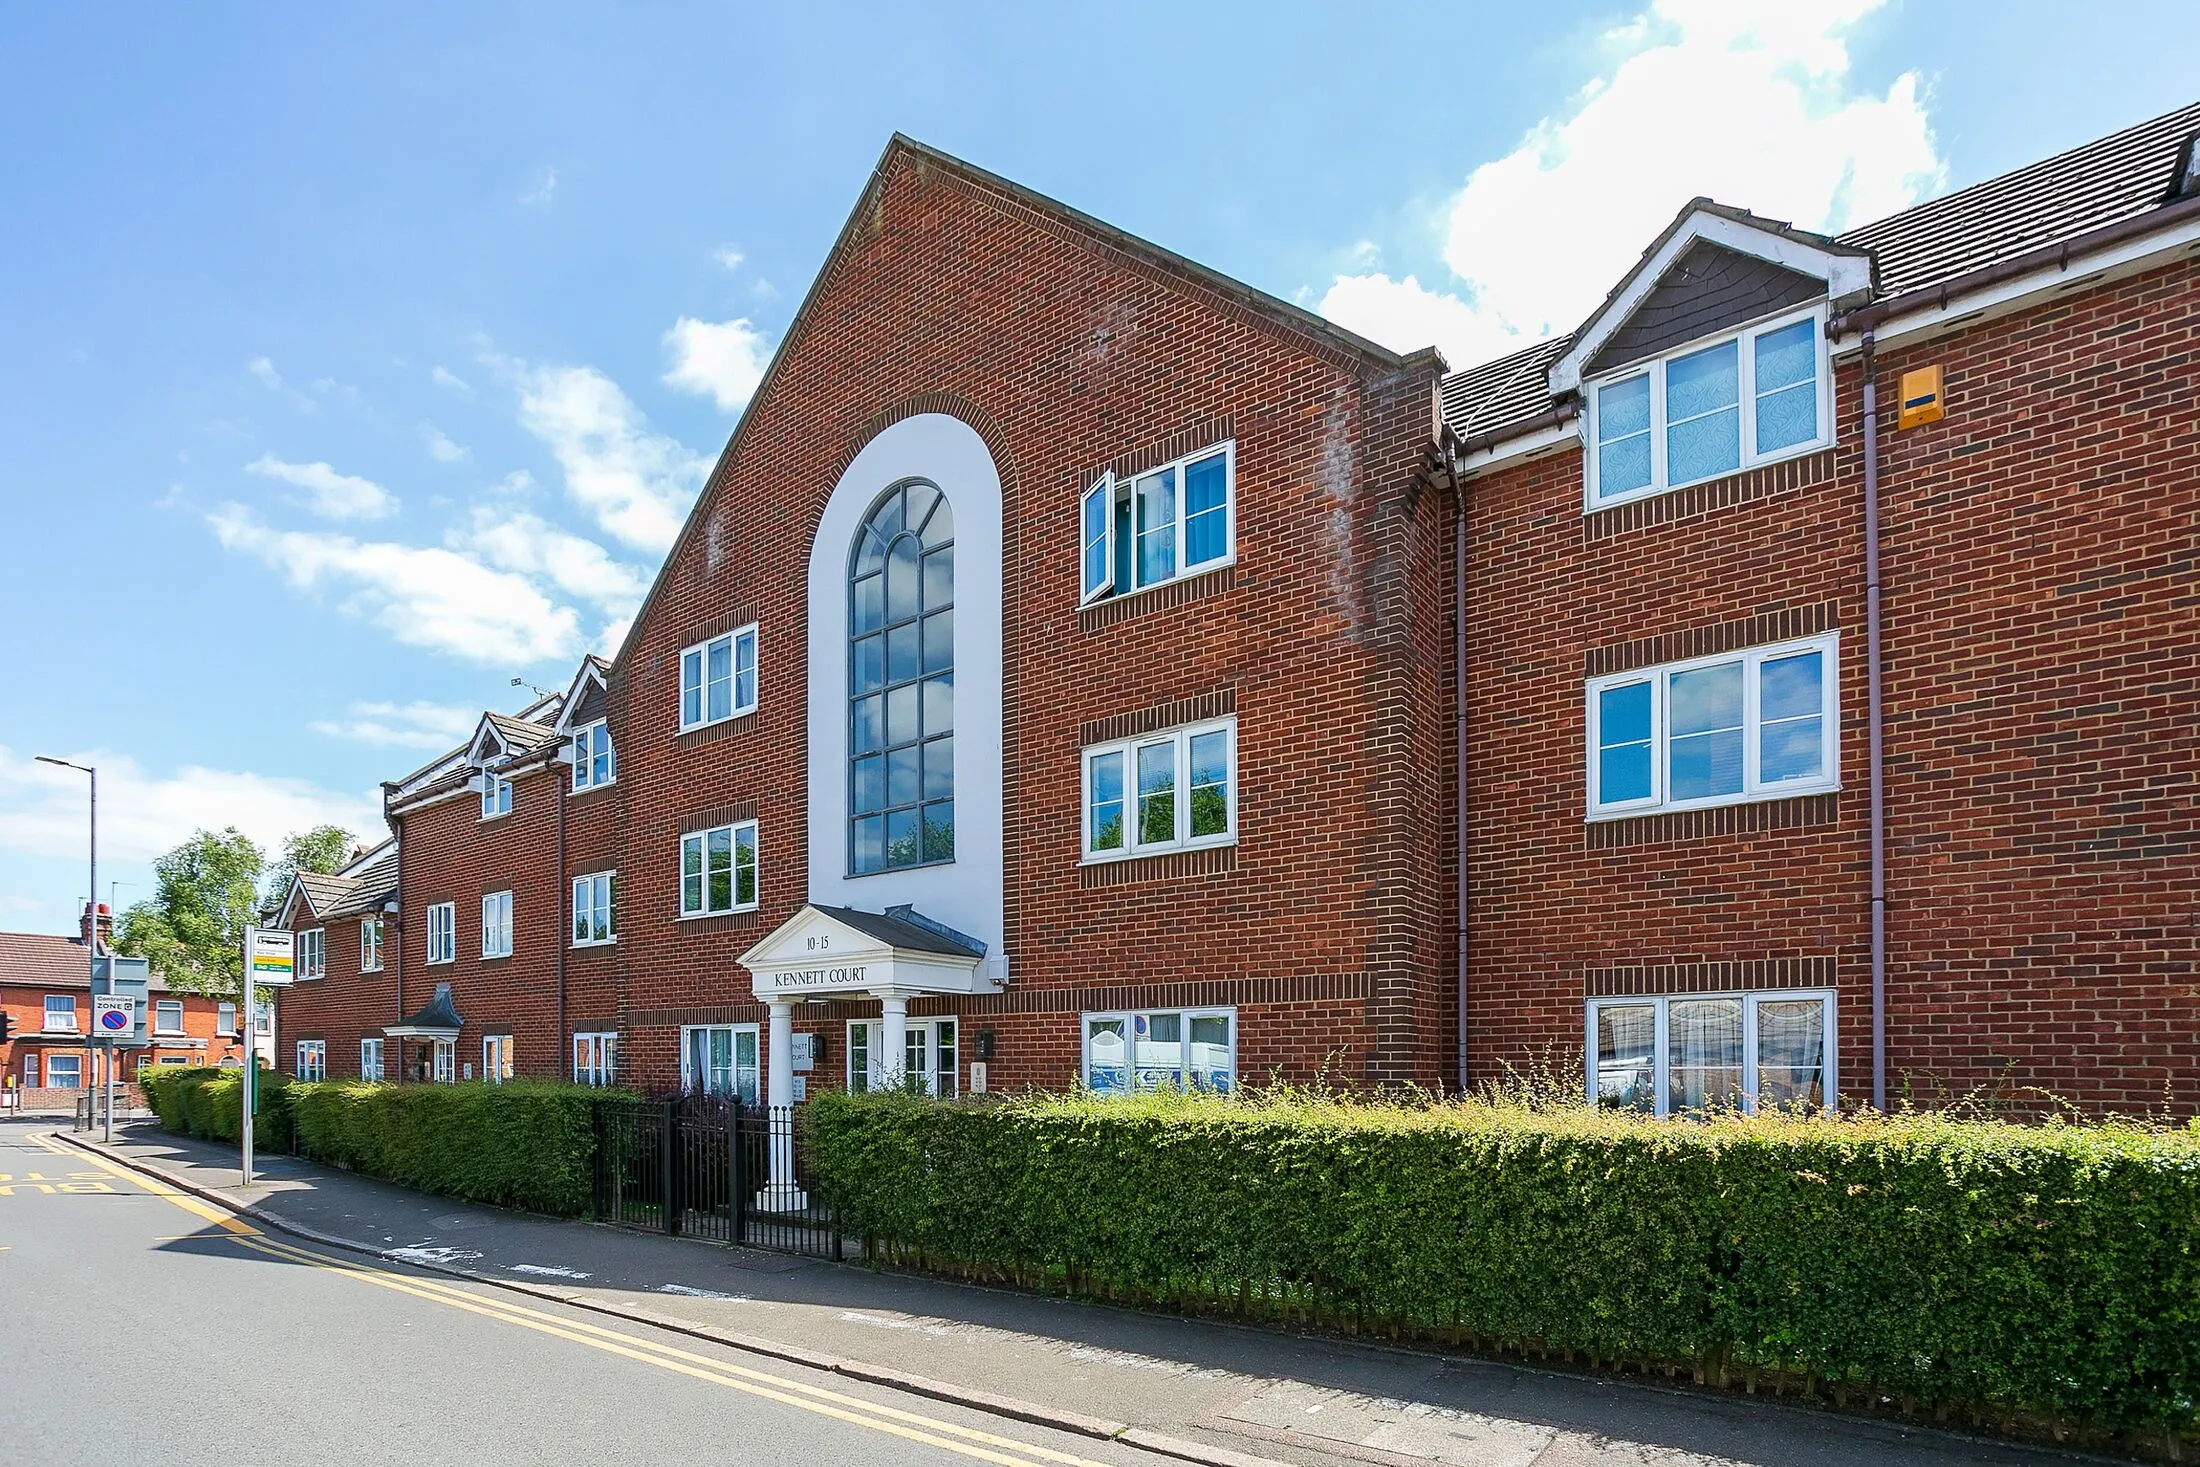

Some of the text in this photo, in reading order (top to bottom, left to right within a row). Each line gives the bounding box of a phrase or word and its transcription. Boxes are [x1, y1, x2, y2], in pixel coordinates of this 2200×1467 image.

[807, 935, 829, 951] 10-15
[775, 966, 867, 987] KENNETT COURT
[0, 1182, 116, 1196] BU
